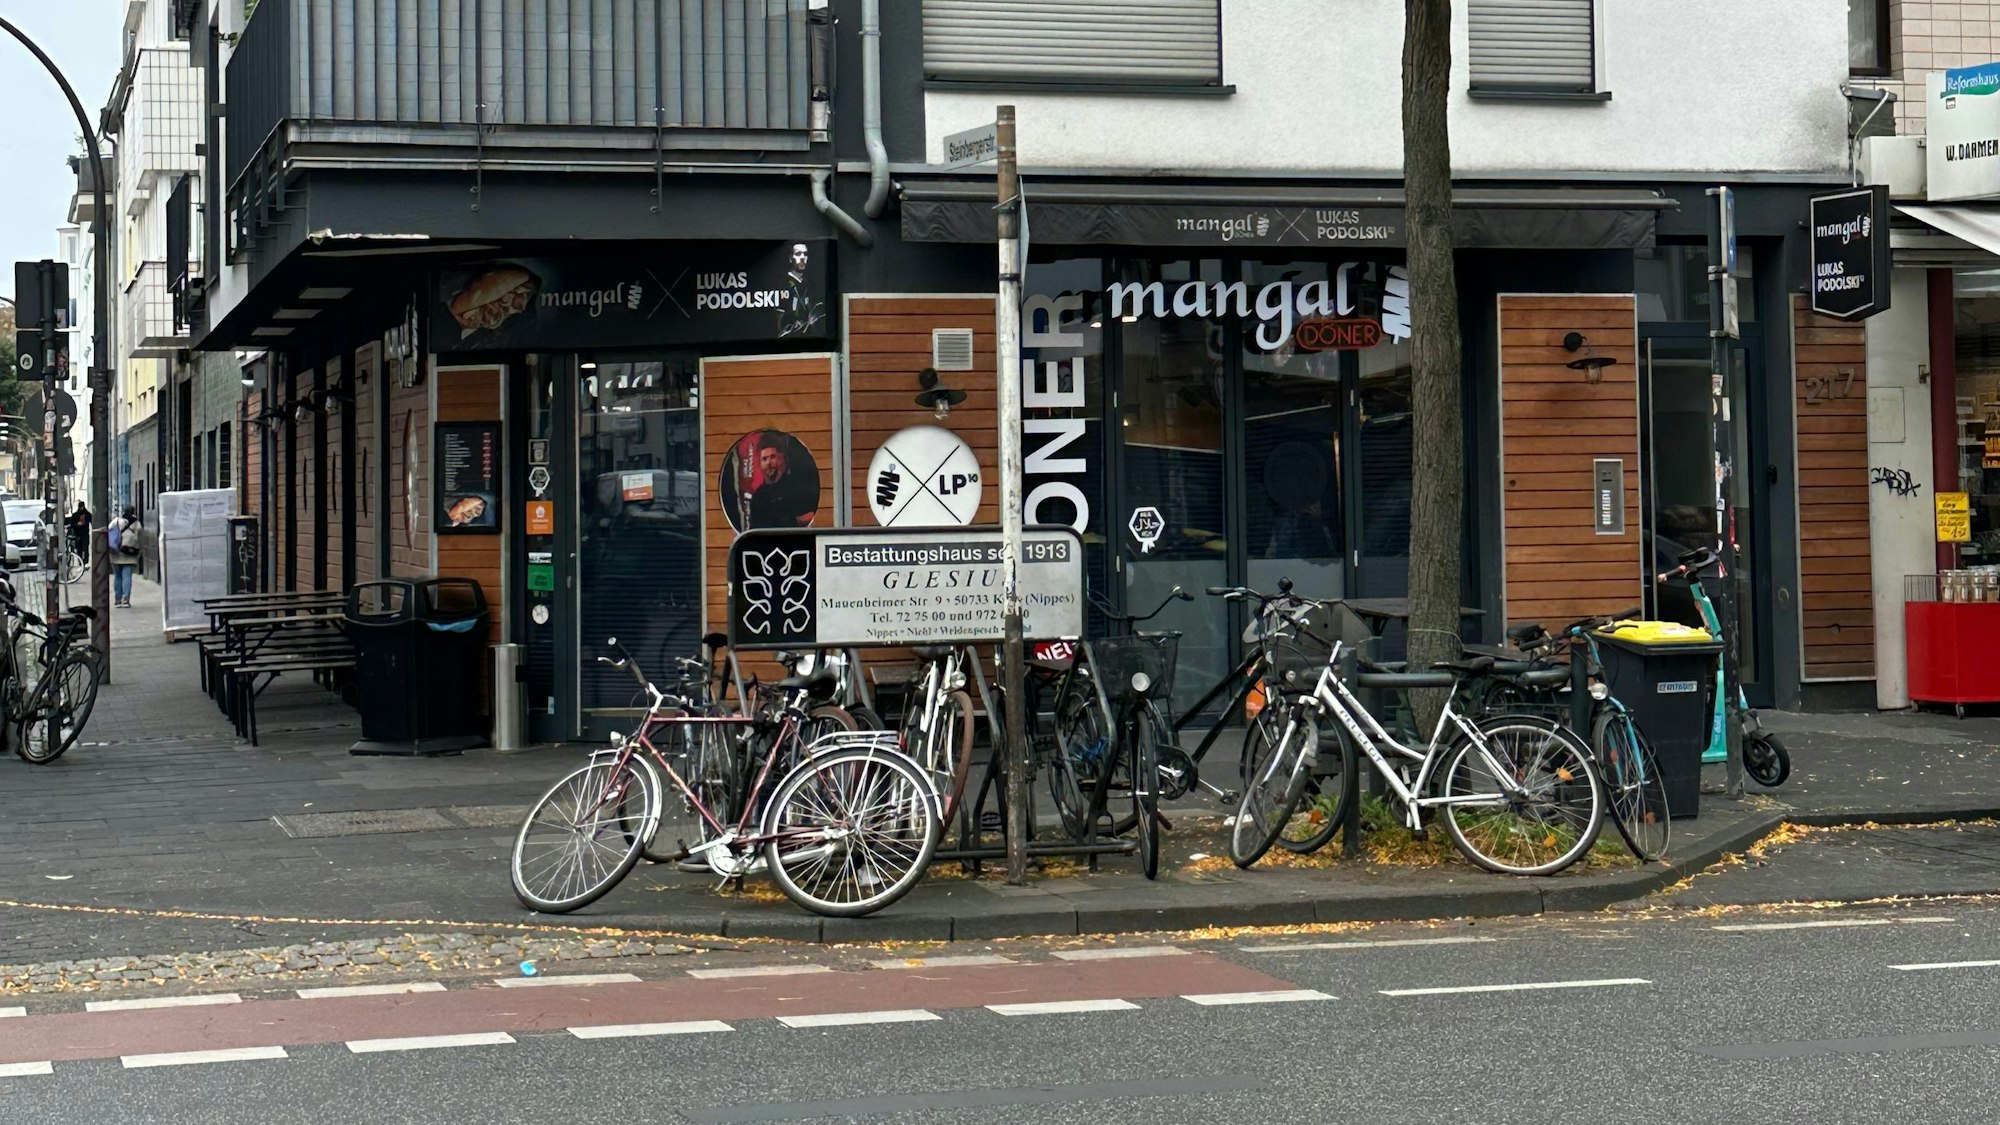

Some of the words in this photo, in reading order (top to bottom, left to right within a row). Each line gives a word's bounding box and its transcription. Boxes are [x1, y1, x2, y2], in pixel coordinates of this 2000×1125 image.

[1176, 214, 1253, 241] mangal
[1316, 211, 1360, 224] LUKAS
[1816, 215, 1862, 245] mangal
[1817, 261, 1844, 277] LUKAS
[697, 272, 748, 290] LUKAS
[540, 282, 625, 317] mangal
[1106, 263, 1357, 350] mangal
[1303, 322, 1375, 346] DÖNER
[1805, 367, 1855, 404] 217
[828, 545, 983, 565] Bestattungshaus
[1025, 543, 1067, 559] 1913
[883, 569, 1005, 589] GLESIU
[821, 597, 906, 609] Mauenheimer
[935, 595, 942, 605] 9
[954, 595, 989, 606] 50733
[1025, 593, 1075, 607] (Nippes)
[870, 612, 893, 623] Tel.
[896, 612, 910, 622] 72
[914, 611, 929, 621] 75
[932, 611, 945, 621] 00
[949, 610, 972, 621] und
[976, 610, 997, 620] 972
